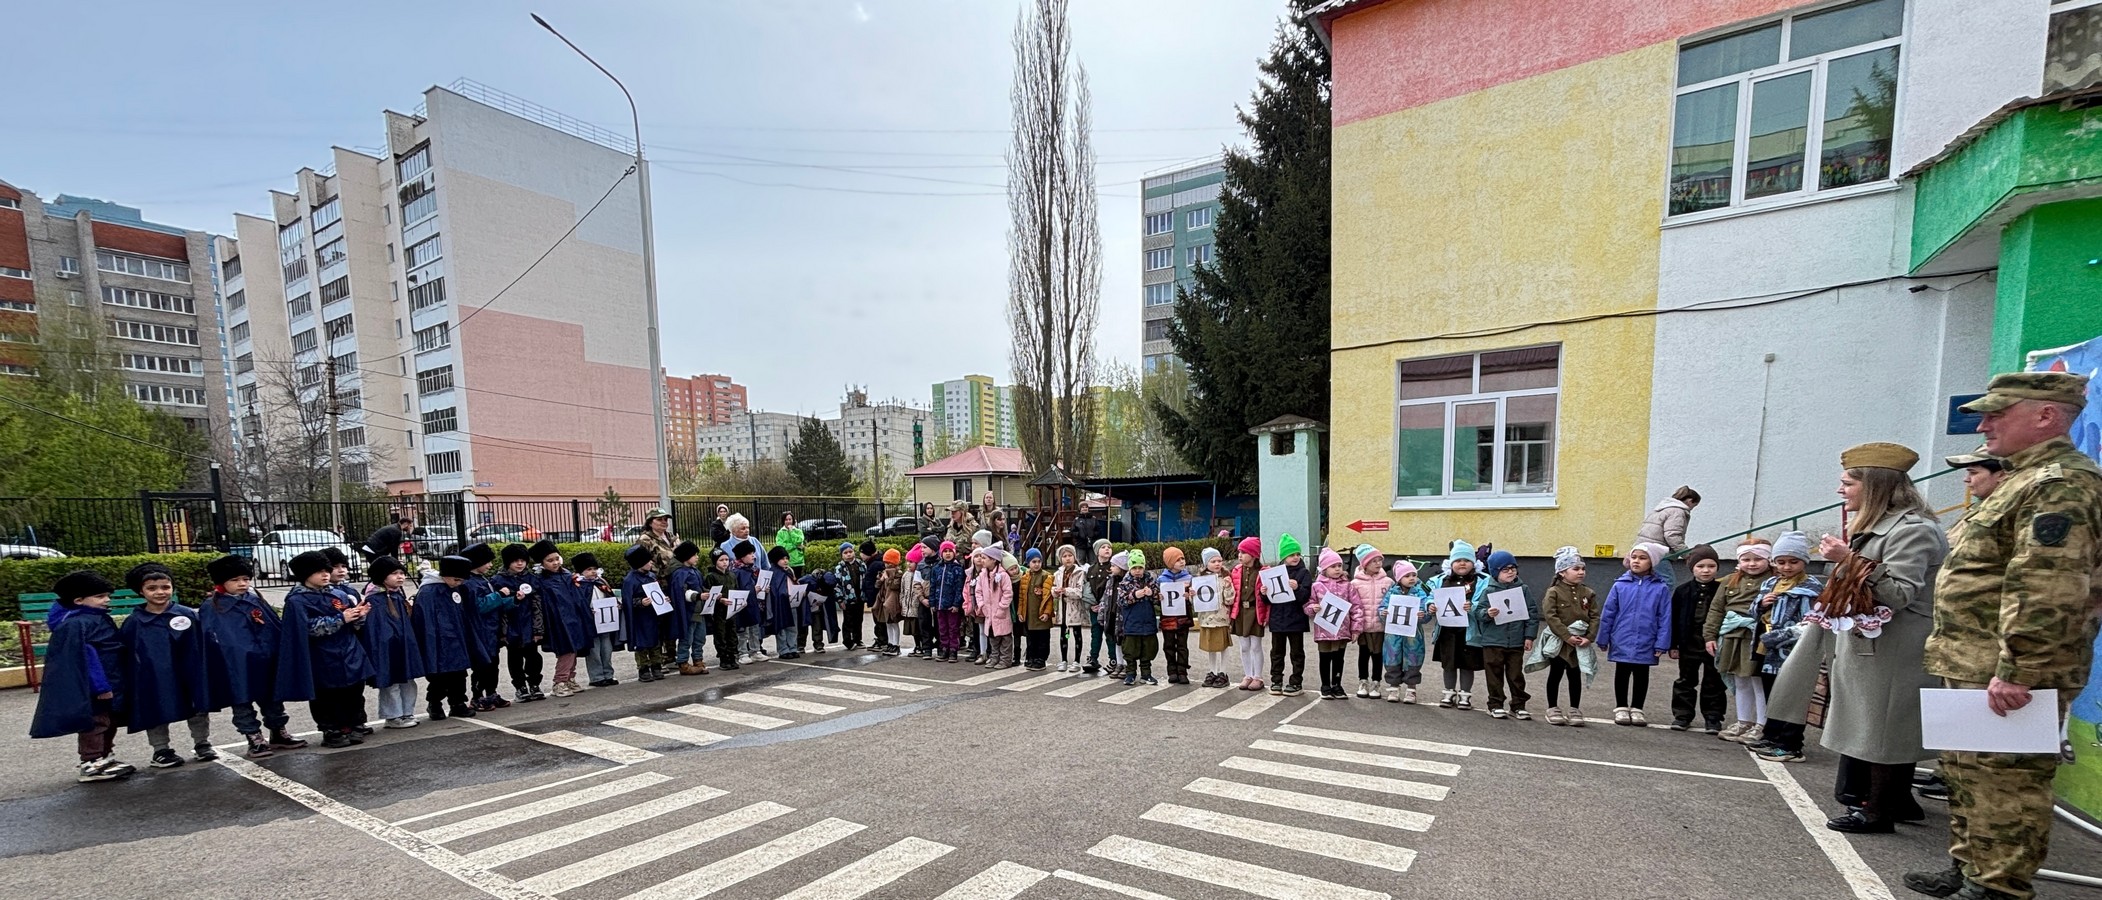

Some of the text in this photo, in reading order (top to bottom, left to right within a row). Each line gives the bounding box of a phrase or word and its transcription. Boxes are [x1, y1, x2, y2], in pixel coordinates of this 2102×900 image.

[598, 605, 616, 625] П
[650, 590, 665, 606] О
[1166, 590, 1180, 608] Р
[1196, 584, 1215, 603] О
[1268, 574, 1290, 599] Д
[1321, 602, 1344, 627] И
[1391, 604, 1413, 627] Н
[1442, 597, 1464, 618] А
